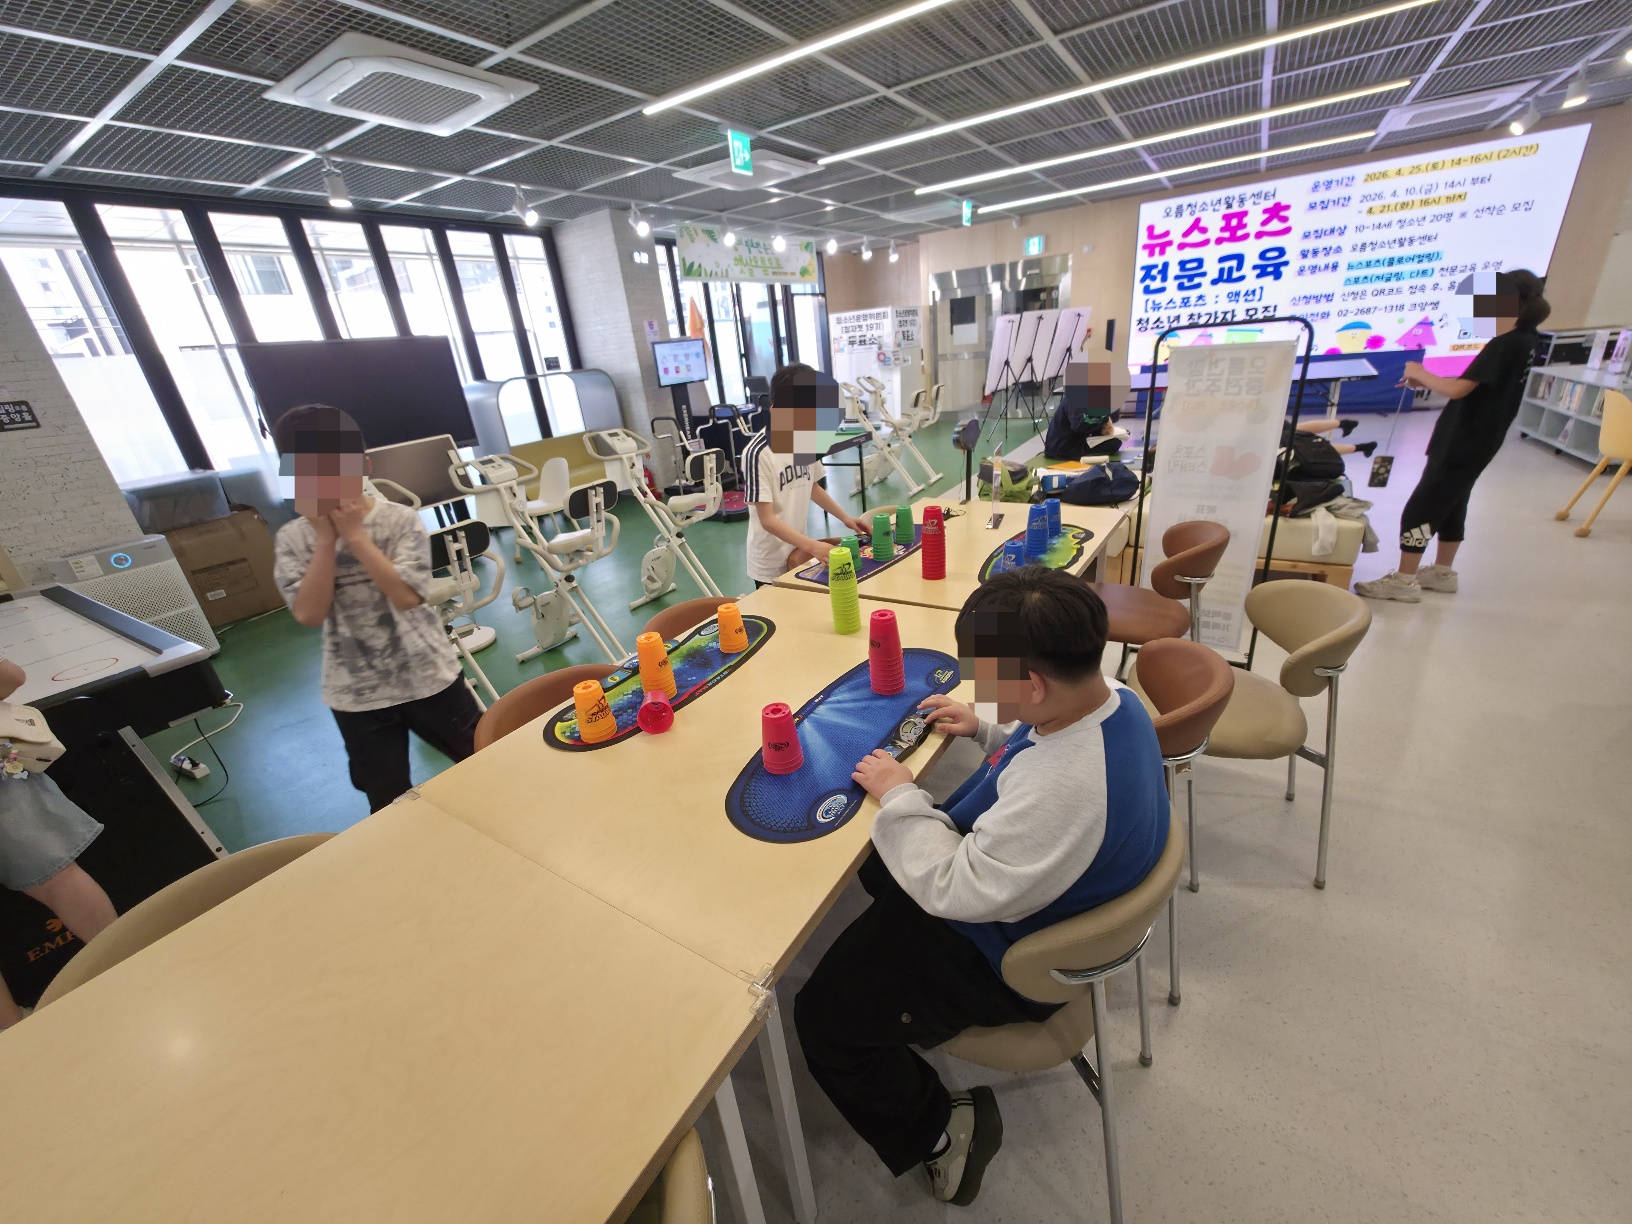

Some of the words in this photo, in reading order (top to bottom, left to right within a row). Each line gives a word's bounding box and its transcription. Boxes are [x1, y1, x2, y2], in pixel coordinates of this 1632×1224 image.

[1311, 175, 1355, 192] 운영기간
[1364, 172, 1390, 182] 2026.
[1395, 168, 1404, 177] 4.
[1497, 143, 1539, 160] (2시간)
[1162, 186, 1277, 219] 오름청소년활동센터
[1308, 195, 1352, 212] 모집기간
[1359, 191, 1386, 203] 2026.
[1390, 189, 1399, 198] 4.
[1405, 182, 1439, 196] 10.(금)
[1444, 178, 1466, 190] 14시
[1470, 173, 1492, 185] 부터
[1380, 199, 1414, 214] 21.(화)
[1420, 196, 1440, 207] 16시
[1445, 192, 1467, 203] 까지
[1142, 202, 1292, 257] 뉴스포츠
[1302, 225, 1347, 240] 모집대상
[1396, 215, 1427, 229] 청소년
[1430, 212, 1454, 223] 20명
[1474, 203, 1506, 219] 선착순
[1511, 200, 1535, 213] 모집
[1300, 245, 1342, 259] 활동장소
[1350, 233, 1438, 253] 오름청소년활동센터
[1139, 246, 1290, 295] 전문교육
[1297, 261, 1339, 276] 운영내용
[1409, 267, 1435, 278] 다트)
[1438, 262, 1477, 277] 전문교육
[1481, 260, 1503, 271] 운영
[1144, 293, 1207, 313] [뉴스포츠
[1227, 286, 1264, 303] 액션]
[1290, 292, 1335, 306] 신청방법
[1341, 289, 1367, 302] 신청은
[1371, 286, 1403, 297] QR코드
[1408, 283, 1426, 295] 접속
[1136, 314, 1181, 332] 청소년
[1188, 309, 1237, 326] 참가자
[1243, 304, 1278, 321] 모집
[1288, 310, 1331, 324] 의전화
[1337, 303, 1405, 318] 02-2687-1318
[682, 404, 692, 441] EXERHEAR
